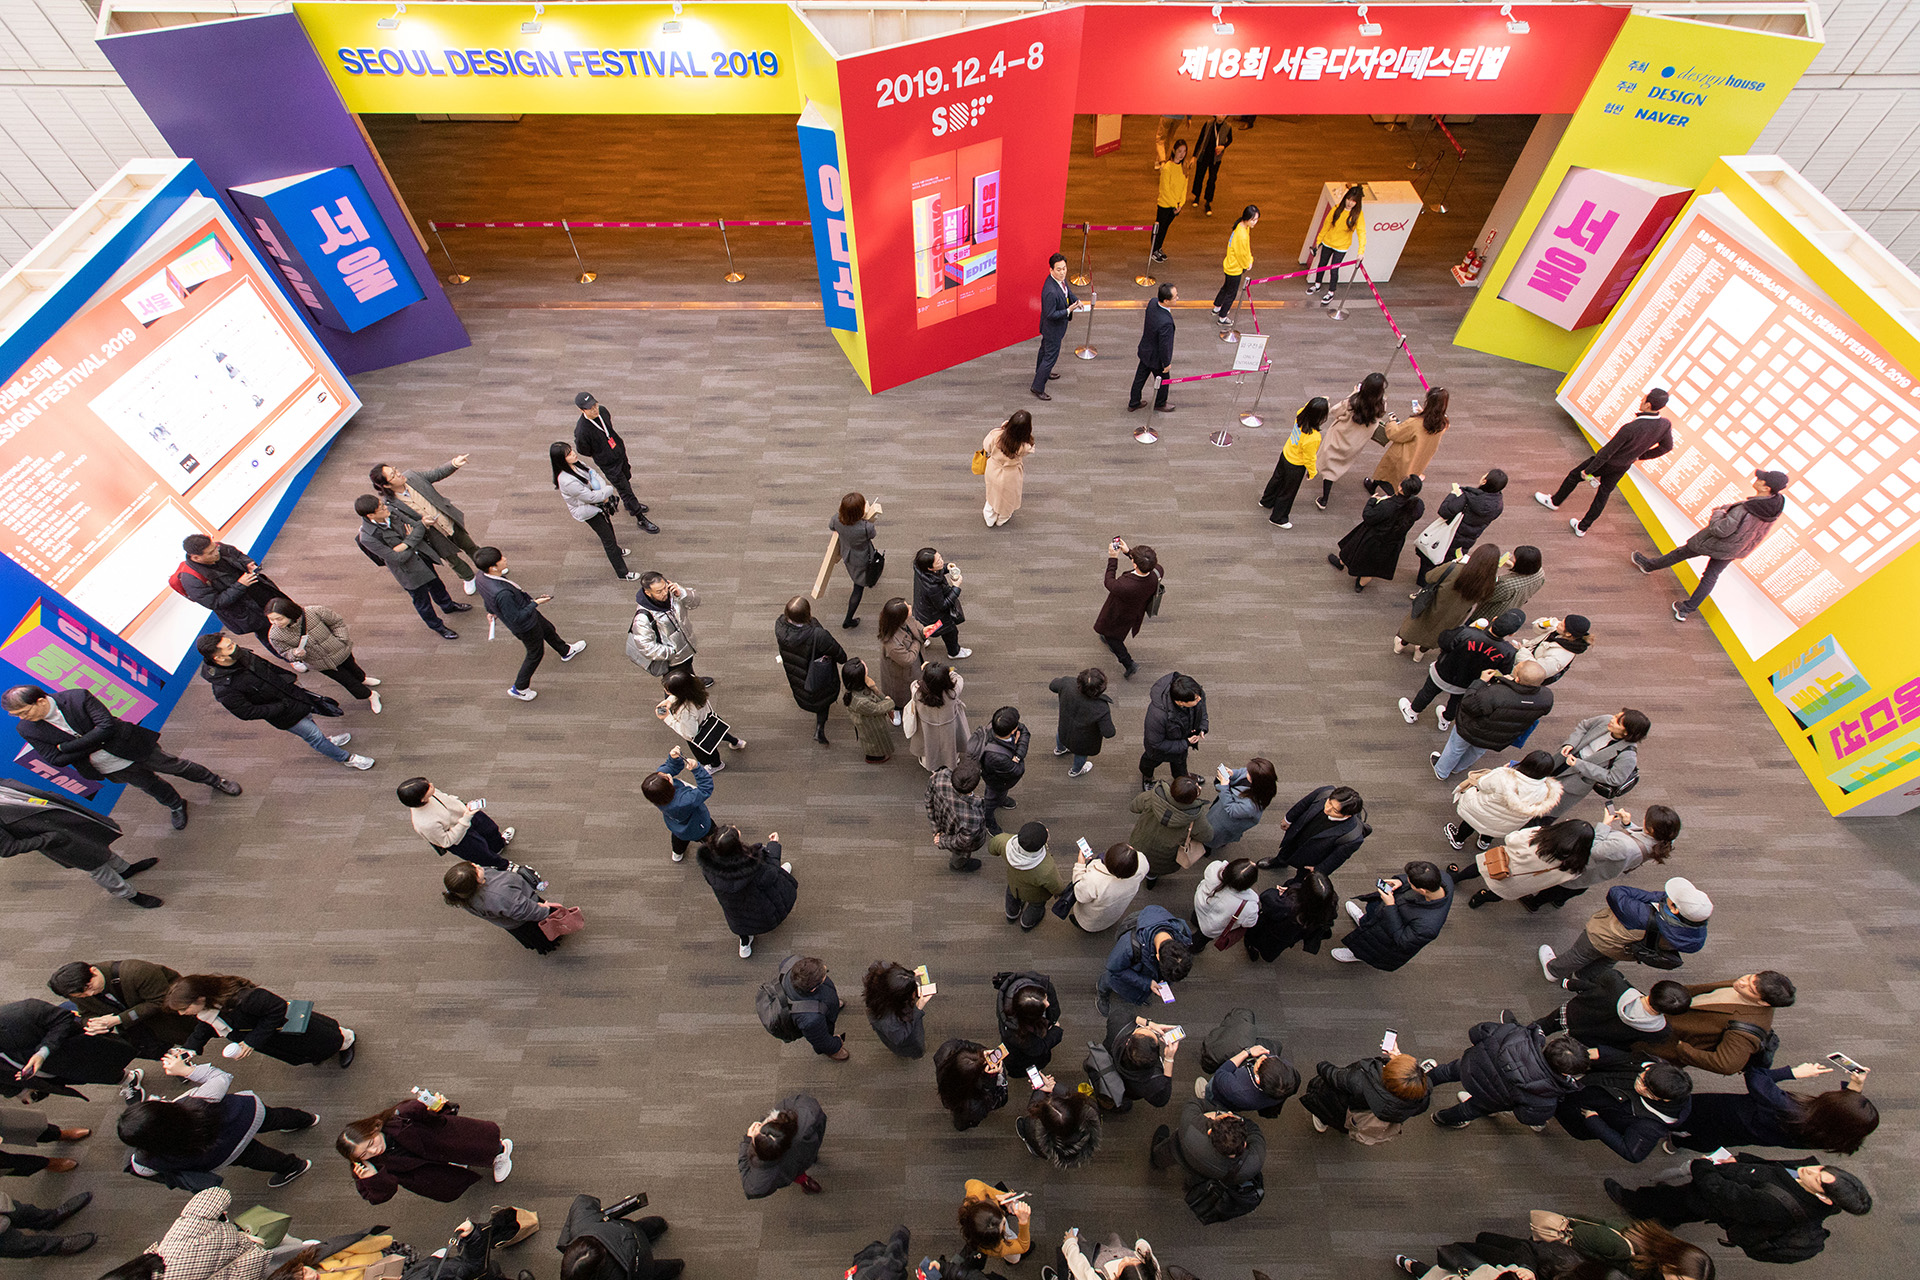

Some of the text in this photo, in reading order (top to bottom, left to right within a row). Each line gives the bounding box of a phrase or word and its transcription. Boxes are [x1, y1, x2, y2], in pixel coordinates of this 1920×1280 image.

[337, 48, 779, 77] SEOUL DESIGN FESTIVAL 2019
[1178, 46, 1510, 81] 제18회 서울디자인페스티벌
[1628, 60, 1650, 74] 주최
[1616, 80, 1708, 107] 주관 DESIGN
[1604, 102, 1690, 128] 협찬 NAVER
[1373, 218, 1409, 232] coex
[1843, 337, 1888, 373] FESTIVAL
[1884, 368, 1911, 388] 2019
[0, 402, 42, 446] SIGN
[33, 353, 108, 411] FESTIVAL
[100, 327, 136, 359] 2019
[1467, 640, 1504, 662] NIKE
